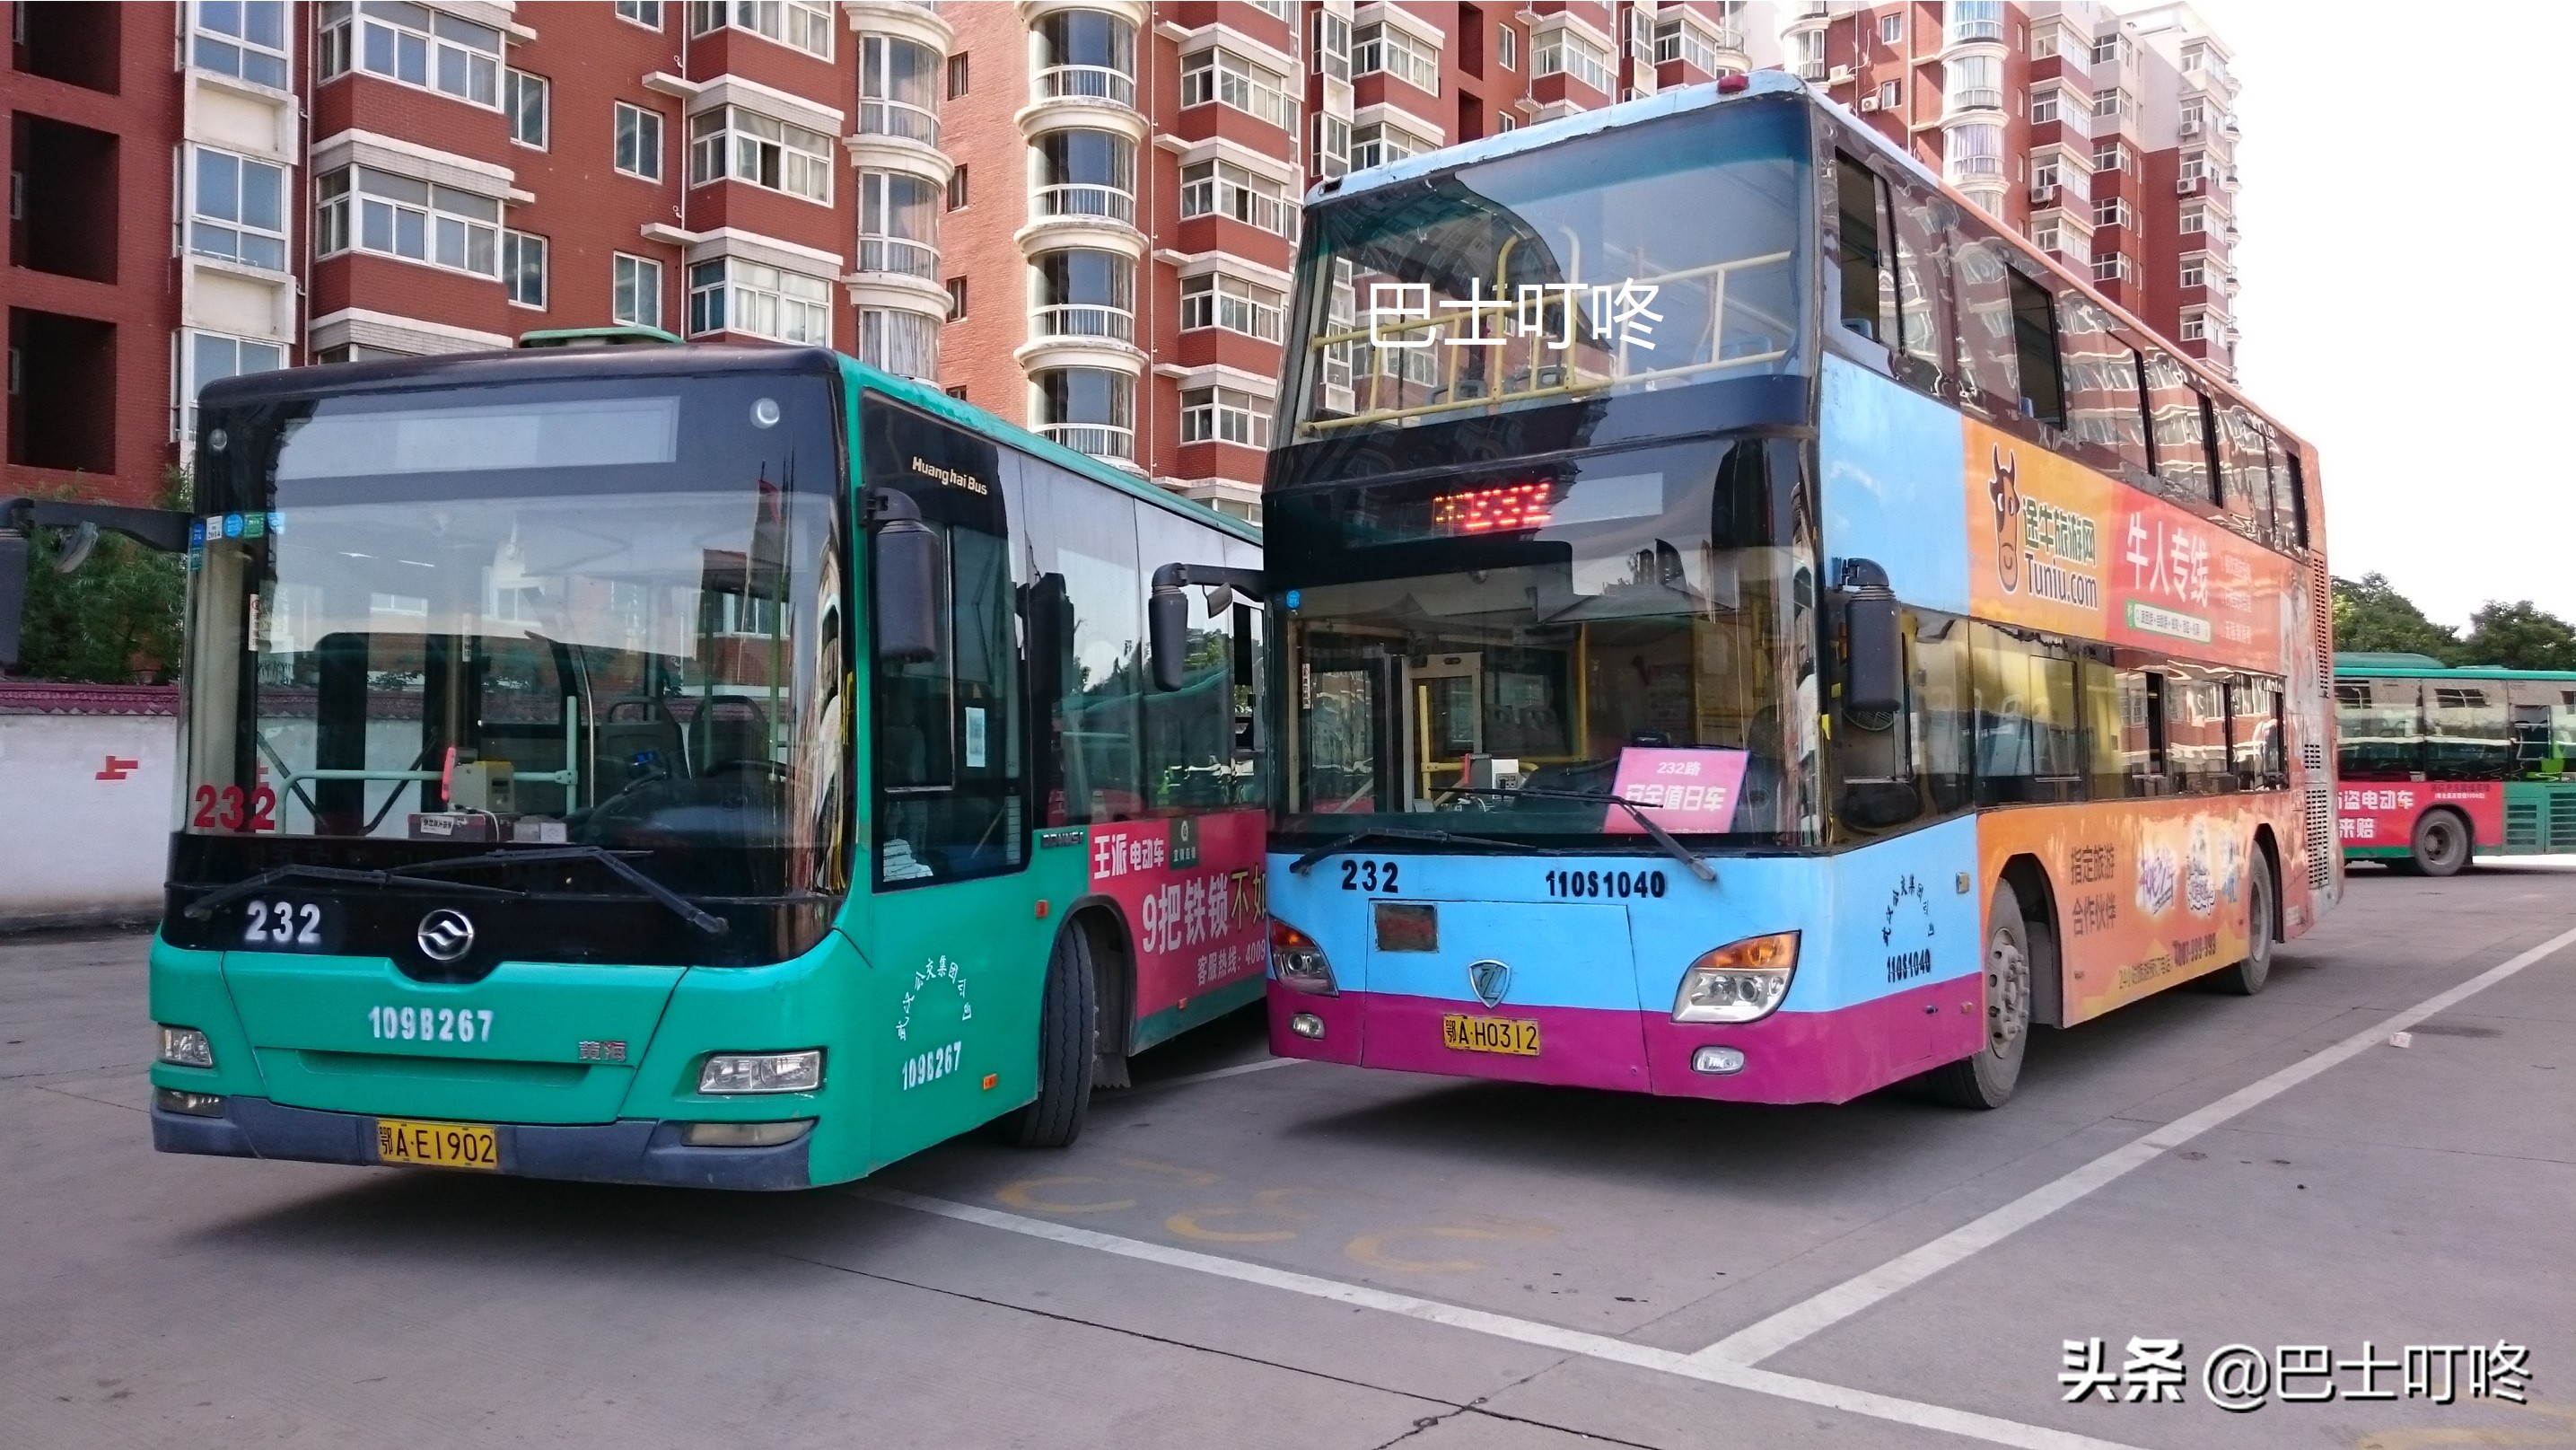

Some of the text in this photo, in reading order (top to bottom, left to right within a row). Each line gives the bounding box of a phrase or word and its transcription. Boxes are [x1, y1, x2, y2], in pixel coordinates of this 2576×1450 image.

[968, 476, 987, 496] Bus
[2022, 497, 2096, 567] 途牛旅游网
[2126, 512, 2208, 608] 牛人专线
[2025, 551, 2098, 610] Tuniu.com
[1657, 761, 1701, 777] 232路
[193, 784, 276, 830] 232
[1625, 784, 1726, 812] 安全值日车
[1130, 838, 1164, 871] 电动车
[2071, 843, 2116, 885] 指定旅游
[1341, 859, 1398, 893] 232
[1546, 870, 1665, 899] 110S1040
[245, 900, 322, 944] 232
[2072, 892, 2116, 937] 合作伙伴
[1887, 948, 1931, 983] 110S1040
[368, 1006, 494, 1042] 109B267
[578, 1041, 627, 1061] 黄海
[901, 1041, 962, 1091] 109B267
